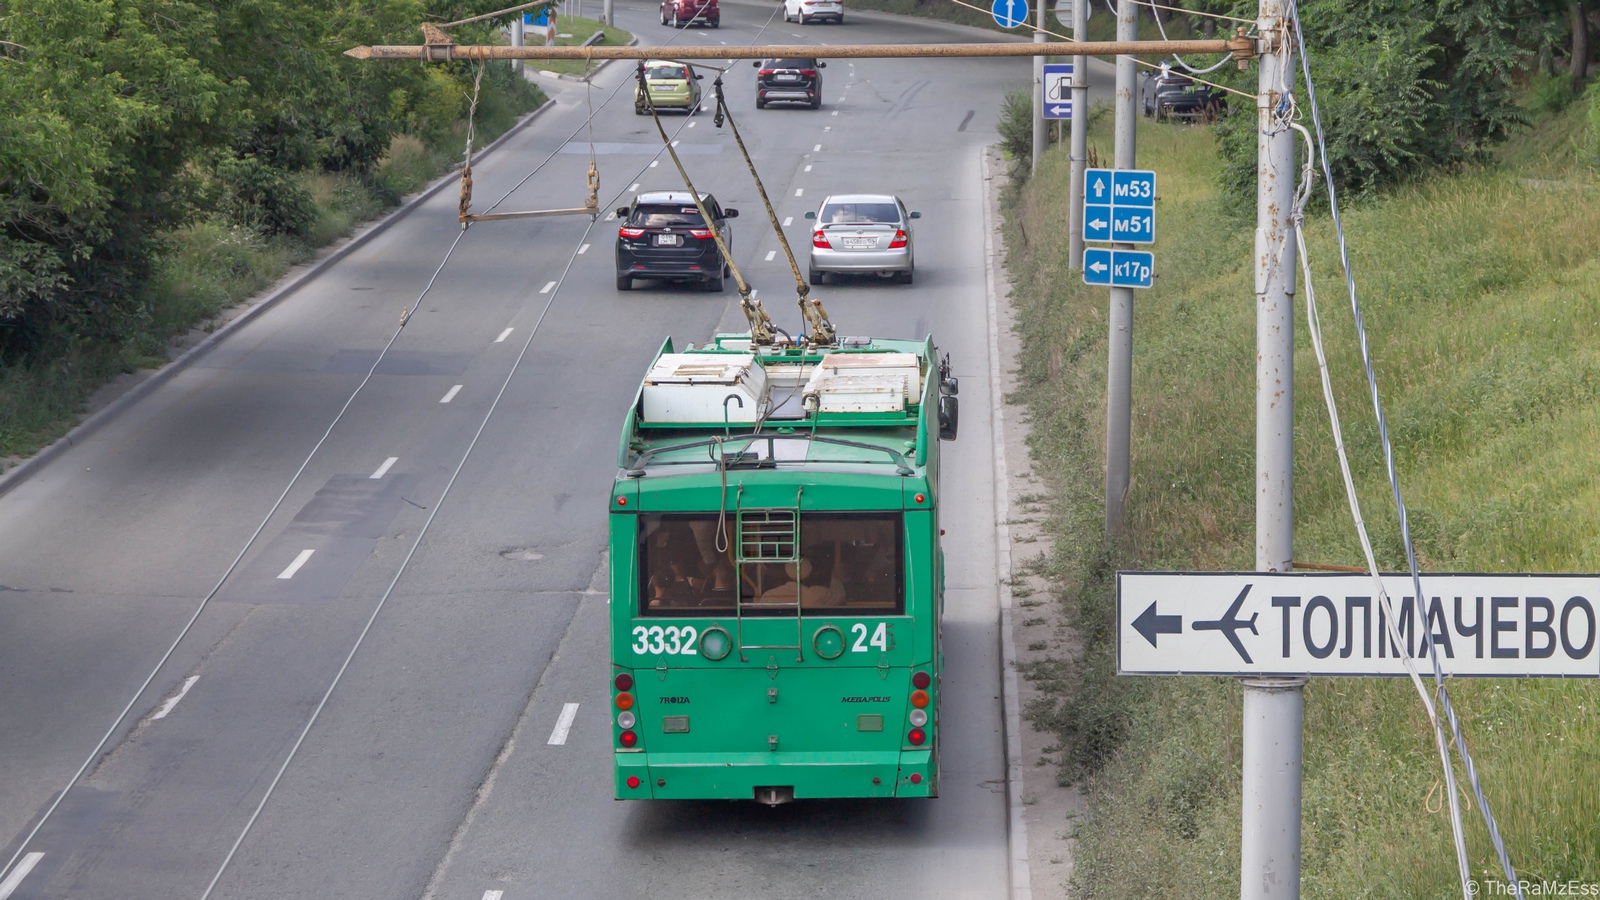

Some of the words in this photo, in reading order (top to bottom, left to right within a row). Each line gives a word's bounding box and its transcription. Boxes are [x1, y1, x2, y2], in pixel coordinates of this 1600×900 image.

[1115, 180, 1151, 198] м53
[1115, 216, 1151, 233] м51
[1114, 261, 1150, 282] к17р
[632, 625, 697, 655] 3332
[851, 622, 887, 653] 24
[1271, 595, 1597, 660] ТОЛМАЧЕВО
